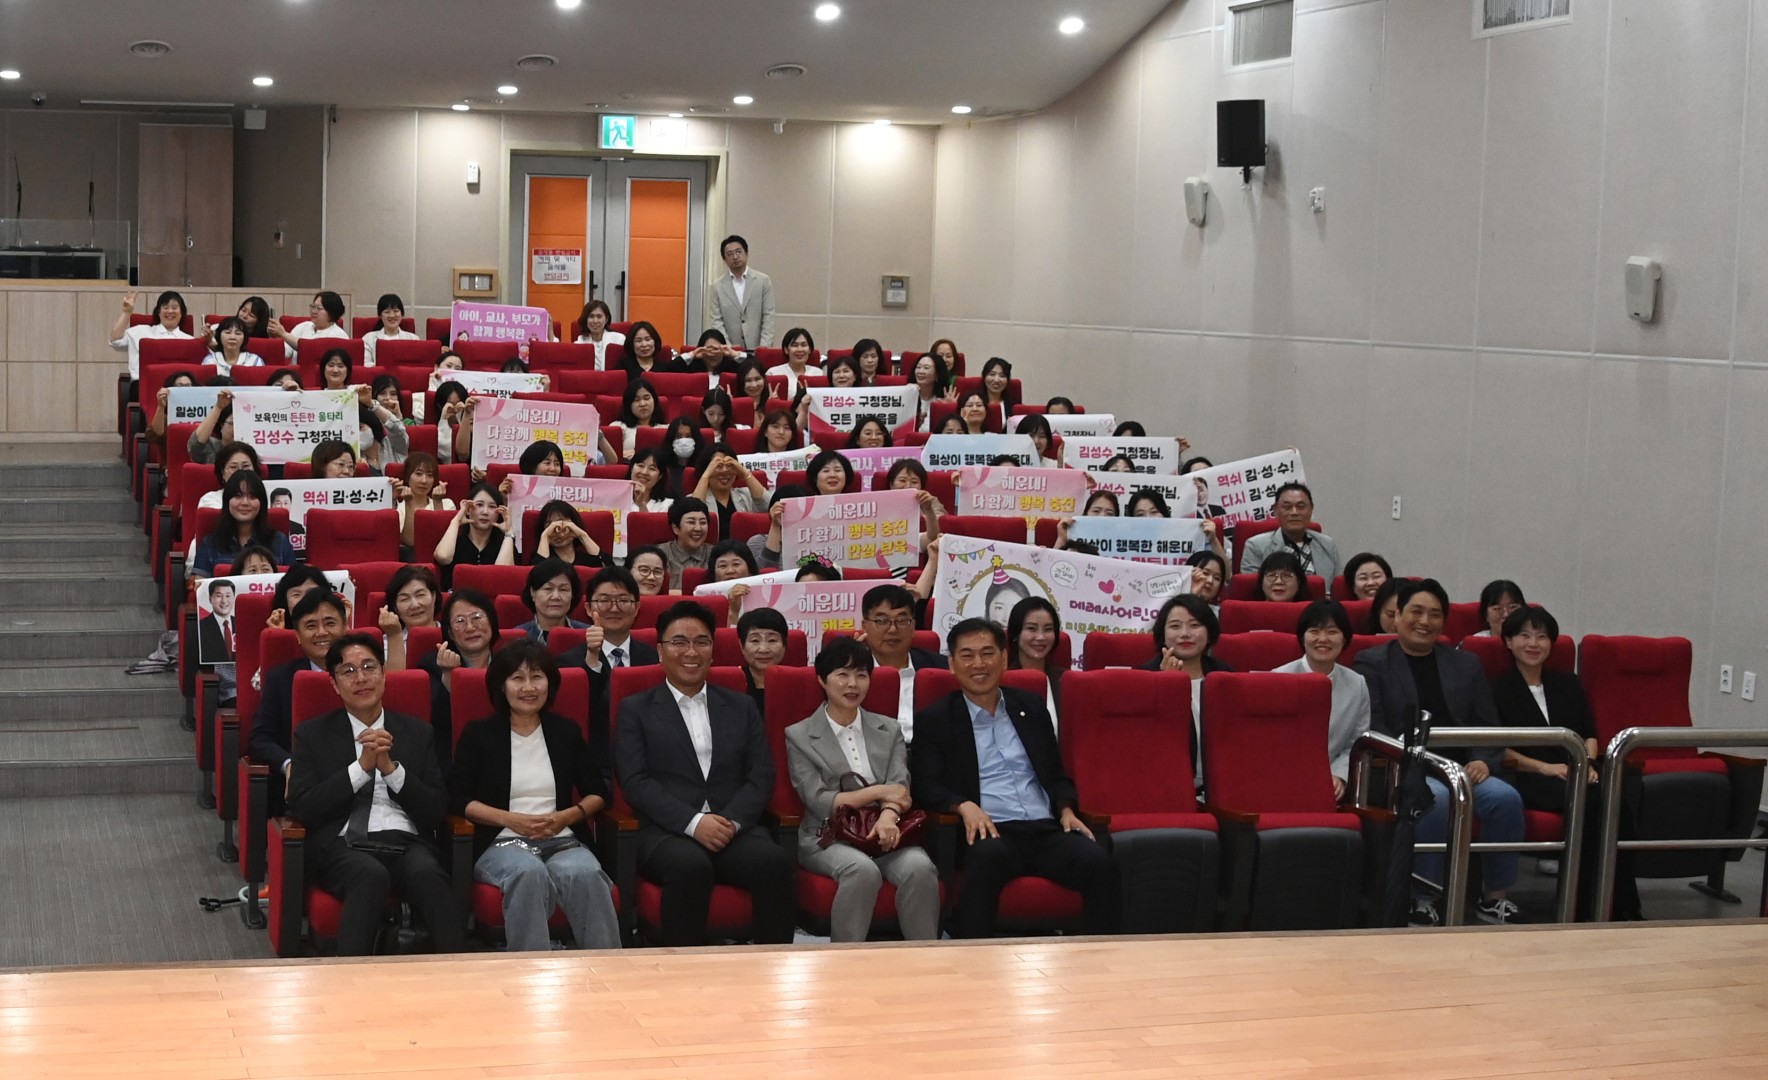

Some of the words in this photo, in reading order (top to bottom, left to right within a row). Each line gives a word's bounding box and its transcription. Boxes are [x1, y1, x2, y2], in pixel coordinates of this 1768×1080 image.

[459, 309, 483, 323] 아이,
[486, 311, 509, 325] 교사,
[512, 313, 542, 326] 부모가
[473, 325, 494, 337] 함께
[496, 327, 525, 340] 행복한
[823, 396, 856, 408] 김성수
[859, 395, 905, 408] 구청장님,
[175, 406, 207, 418] 일상이
[254, 412, 288, 423] 보육인의
[290, 412, 316, 423] 든든한
[318, 411, 343, 422] 울타리
[516, 408, 561, 425] 해운대!
[830, 413, 852, 425] 모든
[253, 430, 295, 445] 김성수
[297, 429, 343, 444] 구청장님
[929, 454, 961, 466] 일상이
[1079, 446, 1113, 459] 김성수
[1001, 475, 1048, 491] 해운대!
[1217, 472, 1242, 487] 역쉬
[303, 490, 329, 505] 역쉬
[550, 486, 594, 502] 해운대!
[1221, 491, 1247, 508] 다시
[828, 502, 878, 520] 해운대!
[1019, 496, 1046, 511] 행복
[848, 521, 877, 539] 행복
[880, 519, 909, 537] 충전
[848, 543, 877, 560] 안심
[880, 539, 908, 556] 보육
[1116, 539, 1153, 553] 행복한
[799, 592, 857, 613] 해운대!
